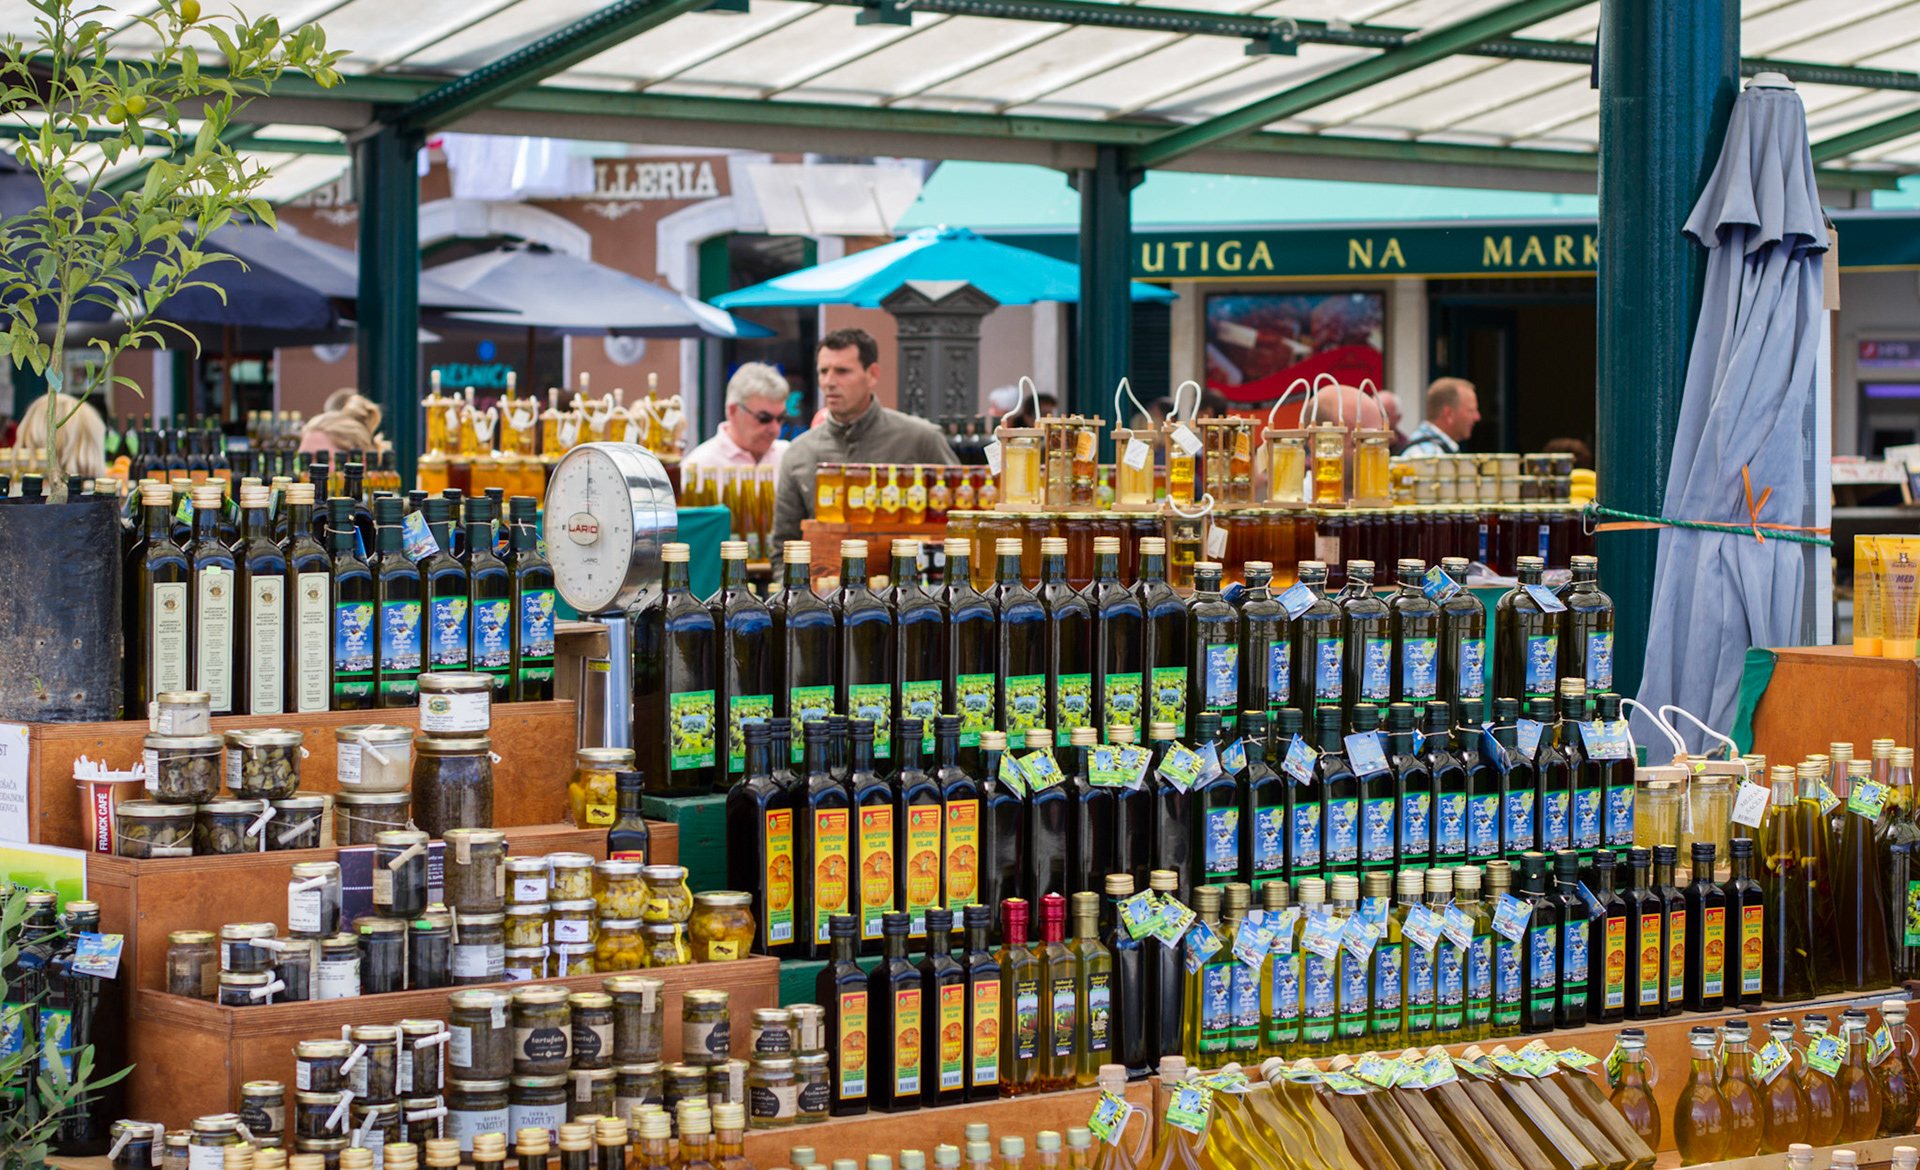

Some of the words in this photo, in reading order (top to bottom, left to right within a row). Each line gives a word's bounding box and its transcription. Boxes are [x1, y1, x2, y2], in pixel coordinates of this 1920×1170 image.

[1141, 240, 1275, 271] UTIGA
[1348, 237, 1407, 268] NA
[568, 525, 598, 534] LARIO
[1896, 575, 1914, 583] MED
[97, 792, 108, 815] CAFÉ
[98, 816, 108, 851] FRANCK
[475, 1120, 506, 1130] TARTUFI
[520, 1116, 556, 1125] TARTUFI
